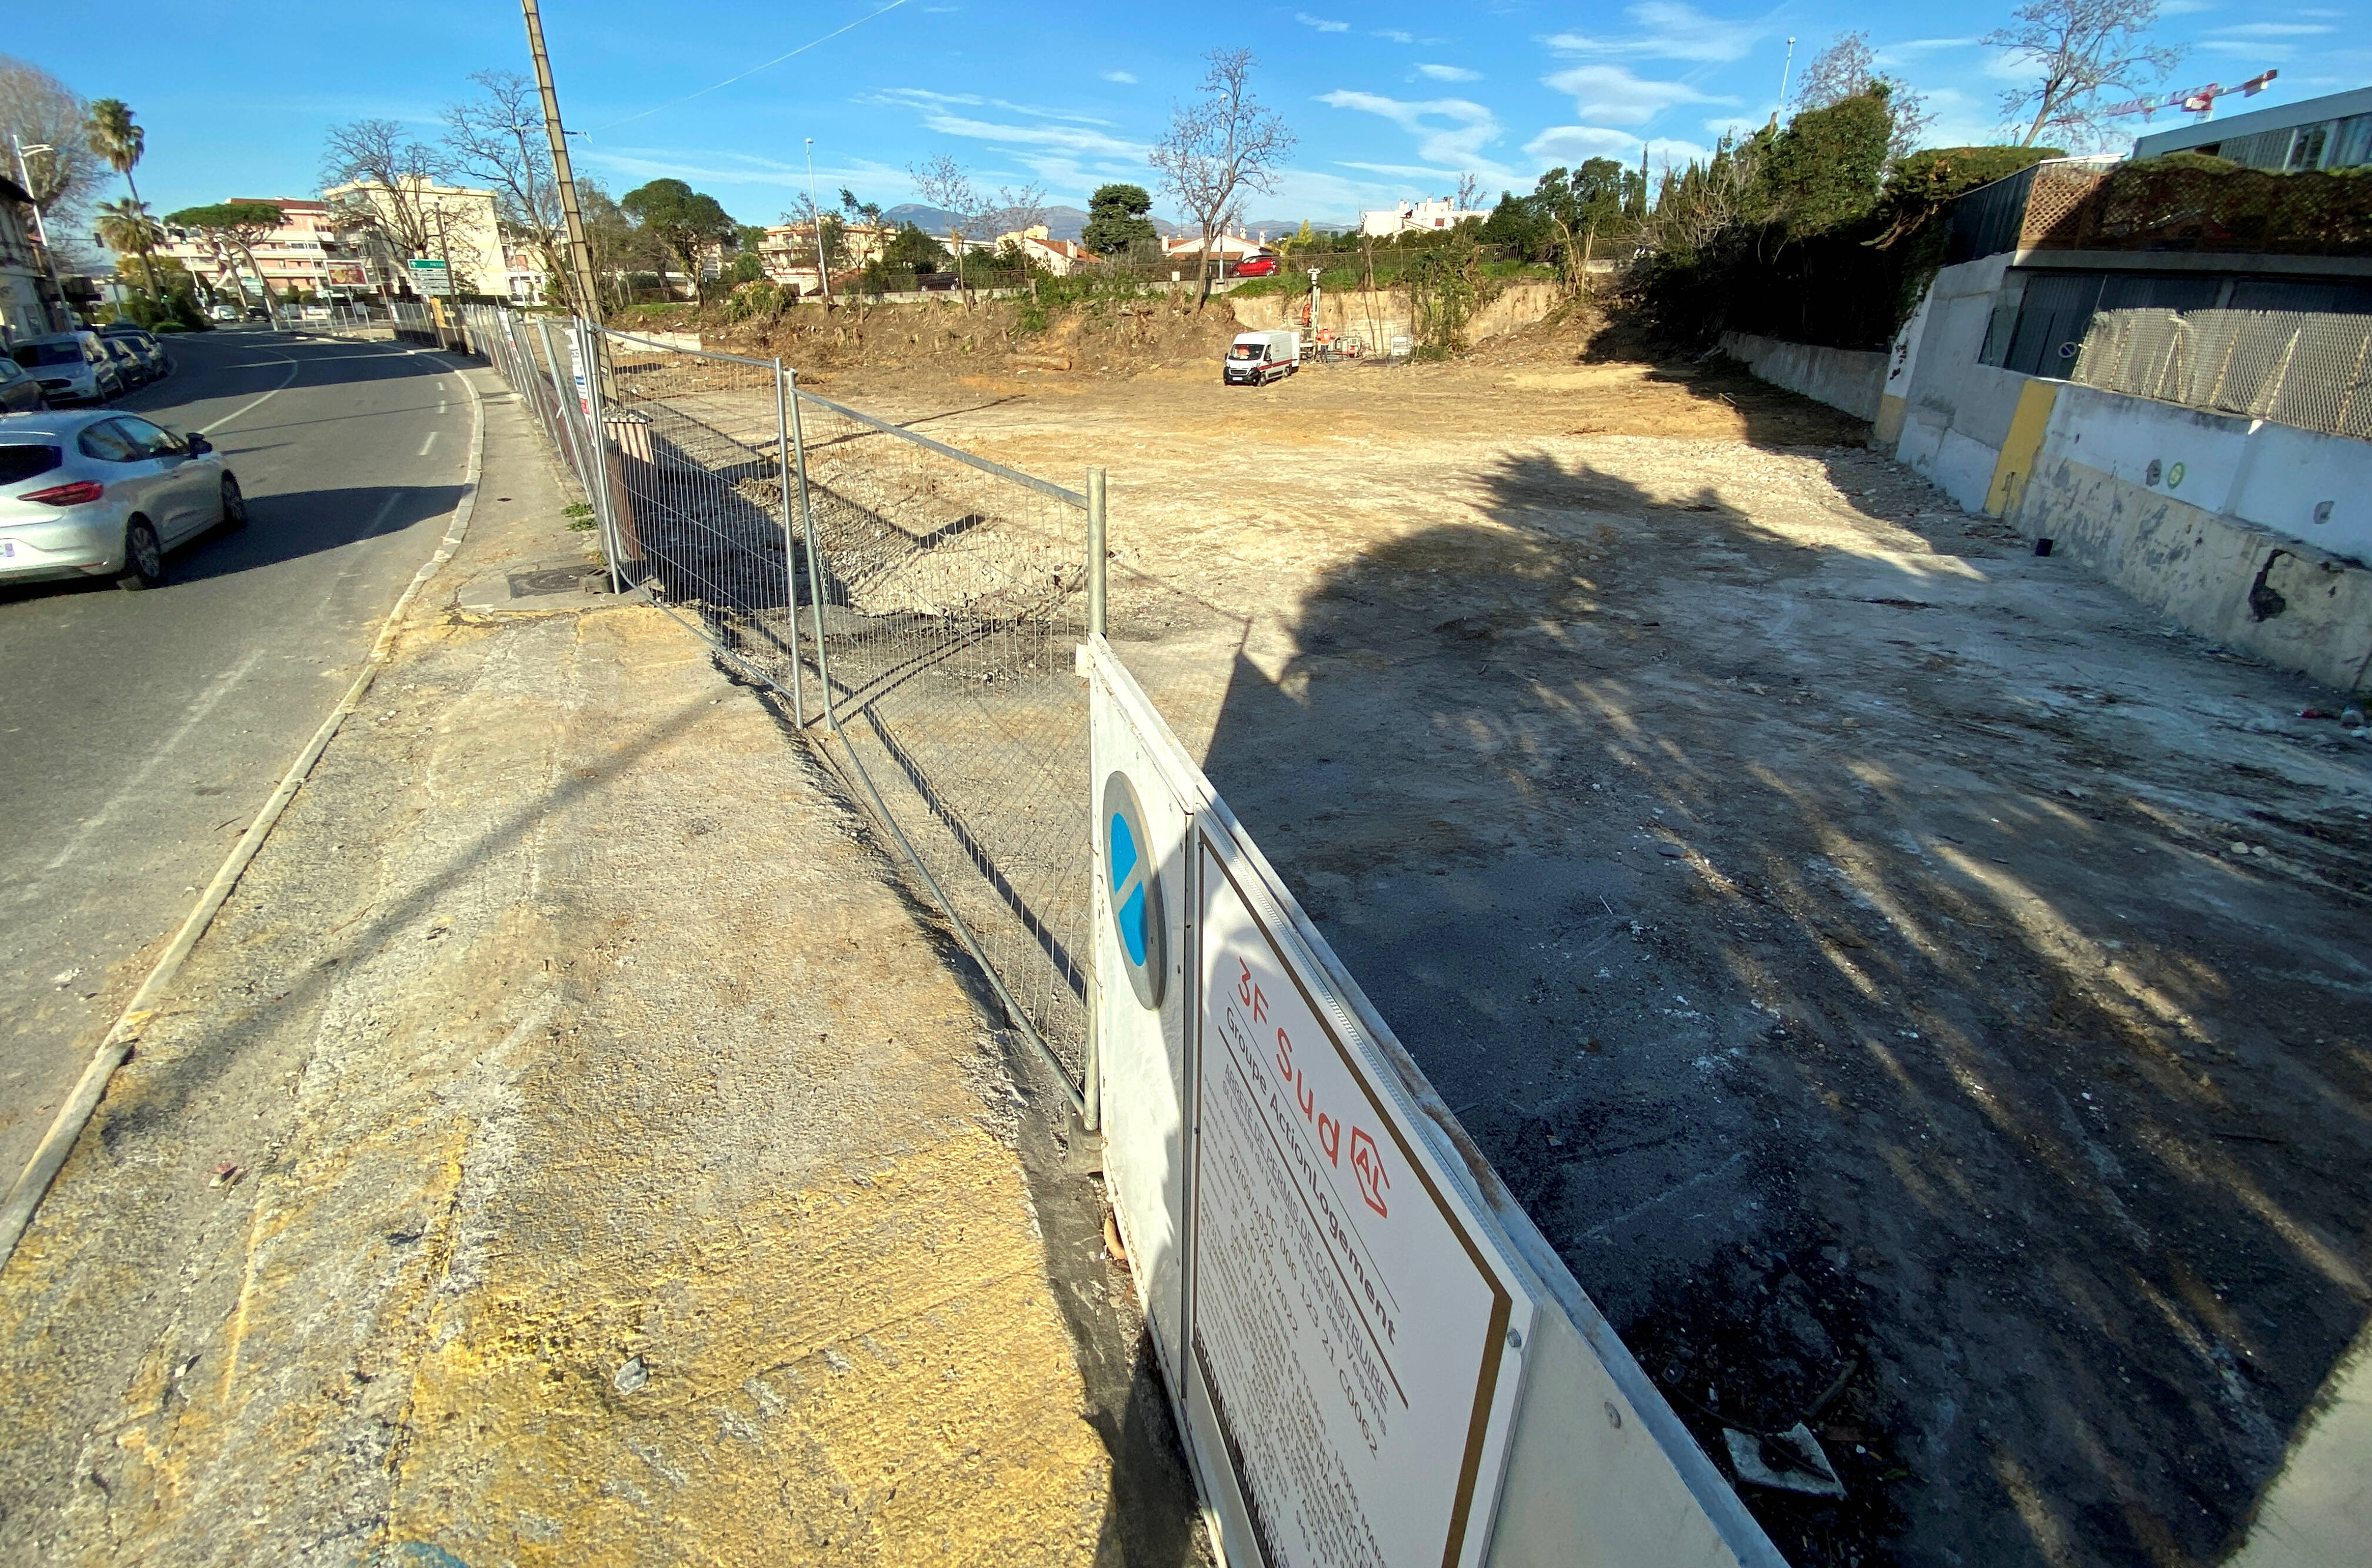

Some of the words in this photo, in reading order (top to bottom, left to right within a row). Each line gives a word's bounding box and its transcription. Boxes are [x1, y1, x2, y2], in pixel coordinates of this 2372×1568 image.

[1227, 1007, 1267, 1096] Groupe
[1270, 1093, 1395, 1346] ActionLogement
[1238, 958, 1268, 1022] 3F
[1277, 1027, 1340, 1167] Sud
[1225, 1063, 1252, 1129] ARRETÉ
[1254, 1122, 1265, 1153] DE
[1267, 1147, 1298, 1223] PERMIS
[1300, 1217, 1314, 1256] DE
[1316, 1252, 1388, 1412] CONSTRUIRE
[1230, 1147, 1274, 1255] 20/09/2022
[1230, 1096, 1254, 1153] Laurent
[1255, 1152, 1264, 1175] du
[1265, 1169, 1278, 1203] Var
[1299, 1242, 1324, 1302] Route
[1326, 1305, 1342, 1343] des
[1346, 1340, 1386, 1436] Vespins
[1250, 1217, 1298, 1338] 22/09/2022
[1230, 1238, 1238, 1260] 20
[1239, 1261, 1248, 1289] rue
[1258, 1309, 1284, 1376] Jacques
[1292, 1392, 1314, 1451] 13286
[1231, 1225, 1252, 1281] CARTA
[1254, 1279, 1286, 1364] REICHEN
[1297, 1384, 1332, 1473] ROBERT
[1231, 1197, 1240, 1220] 3F
[1240, 1222, 1256, 1263] SUD
[1259, 1268, 1266, 1292] 72
[1267, 1290, 1290, 1349] Avenue
[1291, 1350, 1300, 1374] de
[1302, 1370, 1326, 1435] Toulon
[1334, 1450, 1358, 1513] 13006
[1266, 1205, 1278, 1239] PC
[1280, 1237, 1297, 1281] 006
[1300, 1282, 1318, 1328] 123
[1322, 1329, 1334, 1366] 21
[1339, 1369, 1377, 1459] C0062
